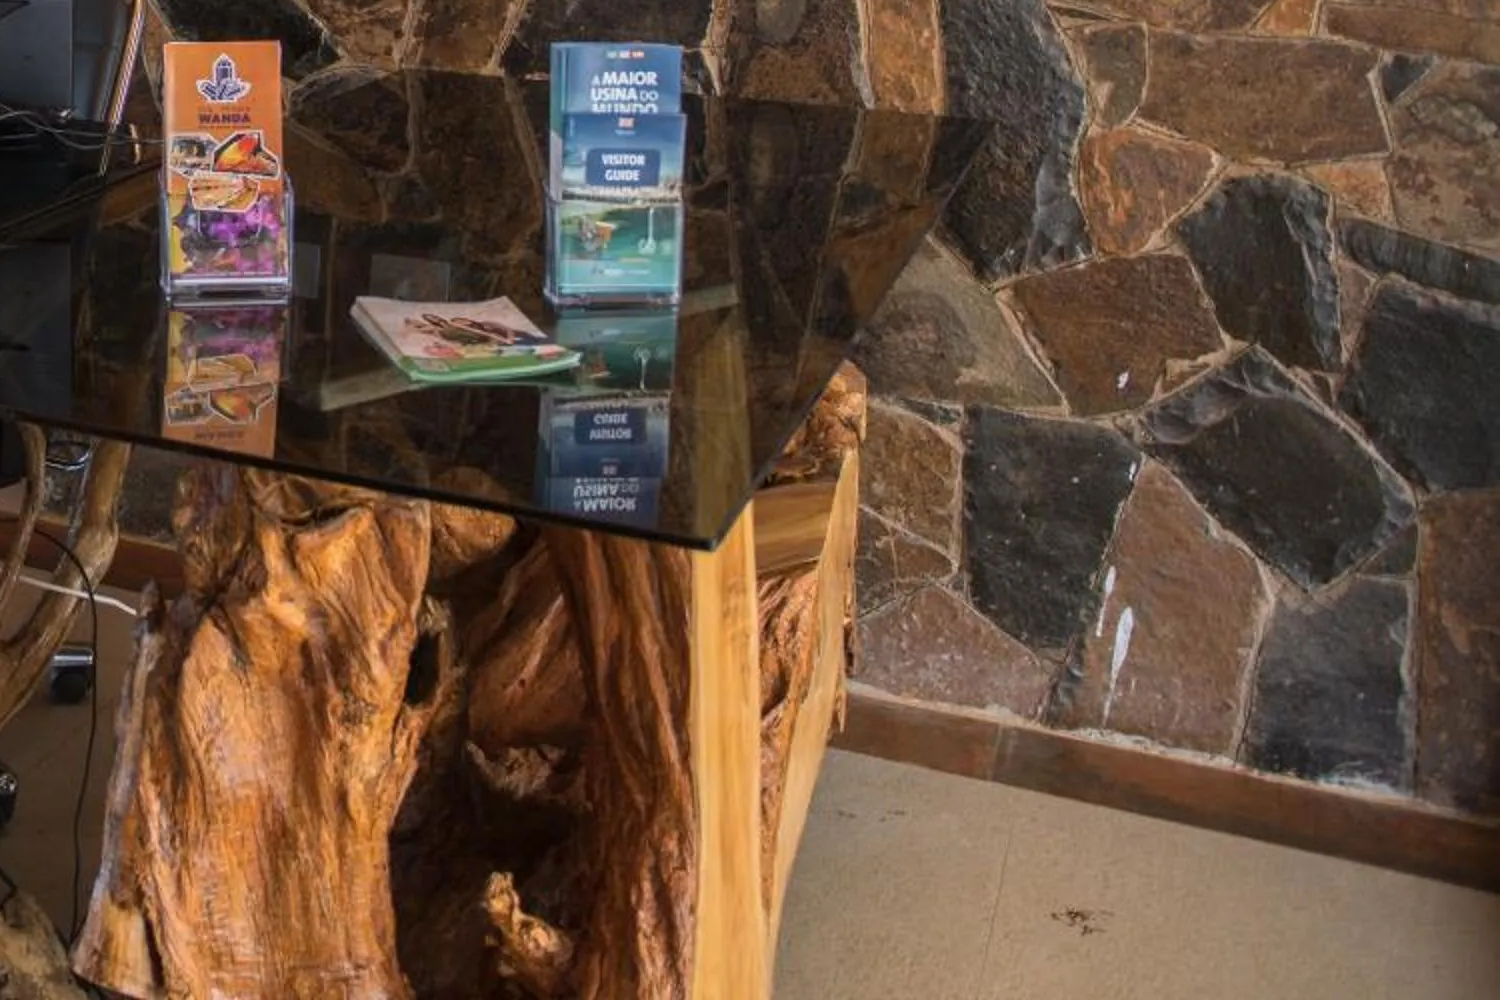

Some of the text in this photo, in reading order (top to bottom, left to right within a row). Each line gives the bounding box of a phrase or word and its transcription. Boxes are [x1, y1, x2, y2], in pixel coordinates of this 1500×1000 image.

[591, 71, 658, 86] A MAIOR
[591, 87, 659, 102] USINA DO
[601, 153, 645, 166] VISITOR
[605, 169, 640, 181] GUIDE
